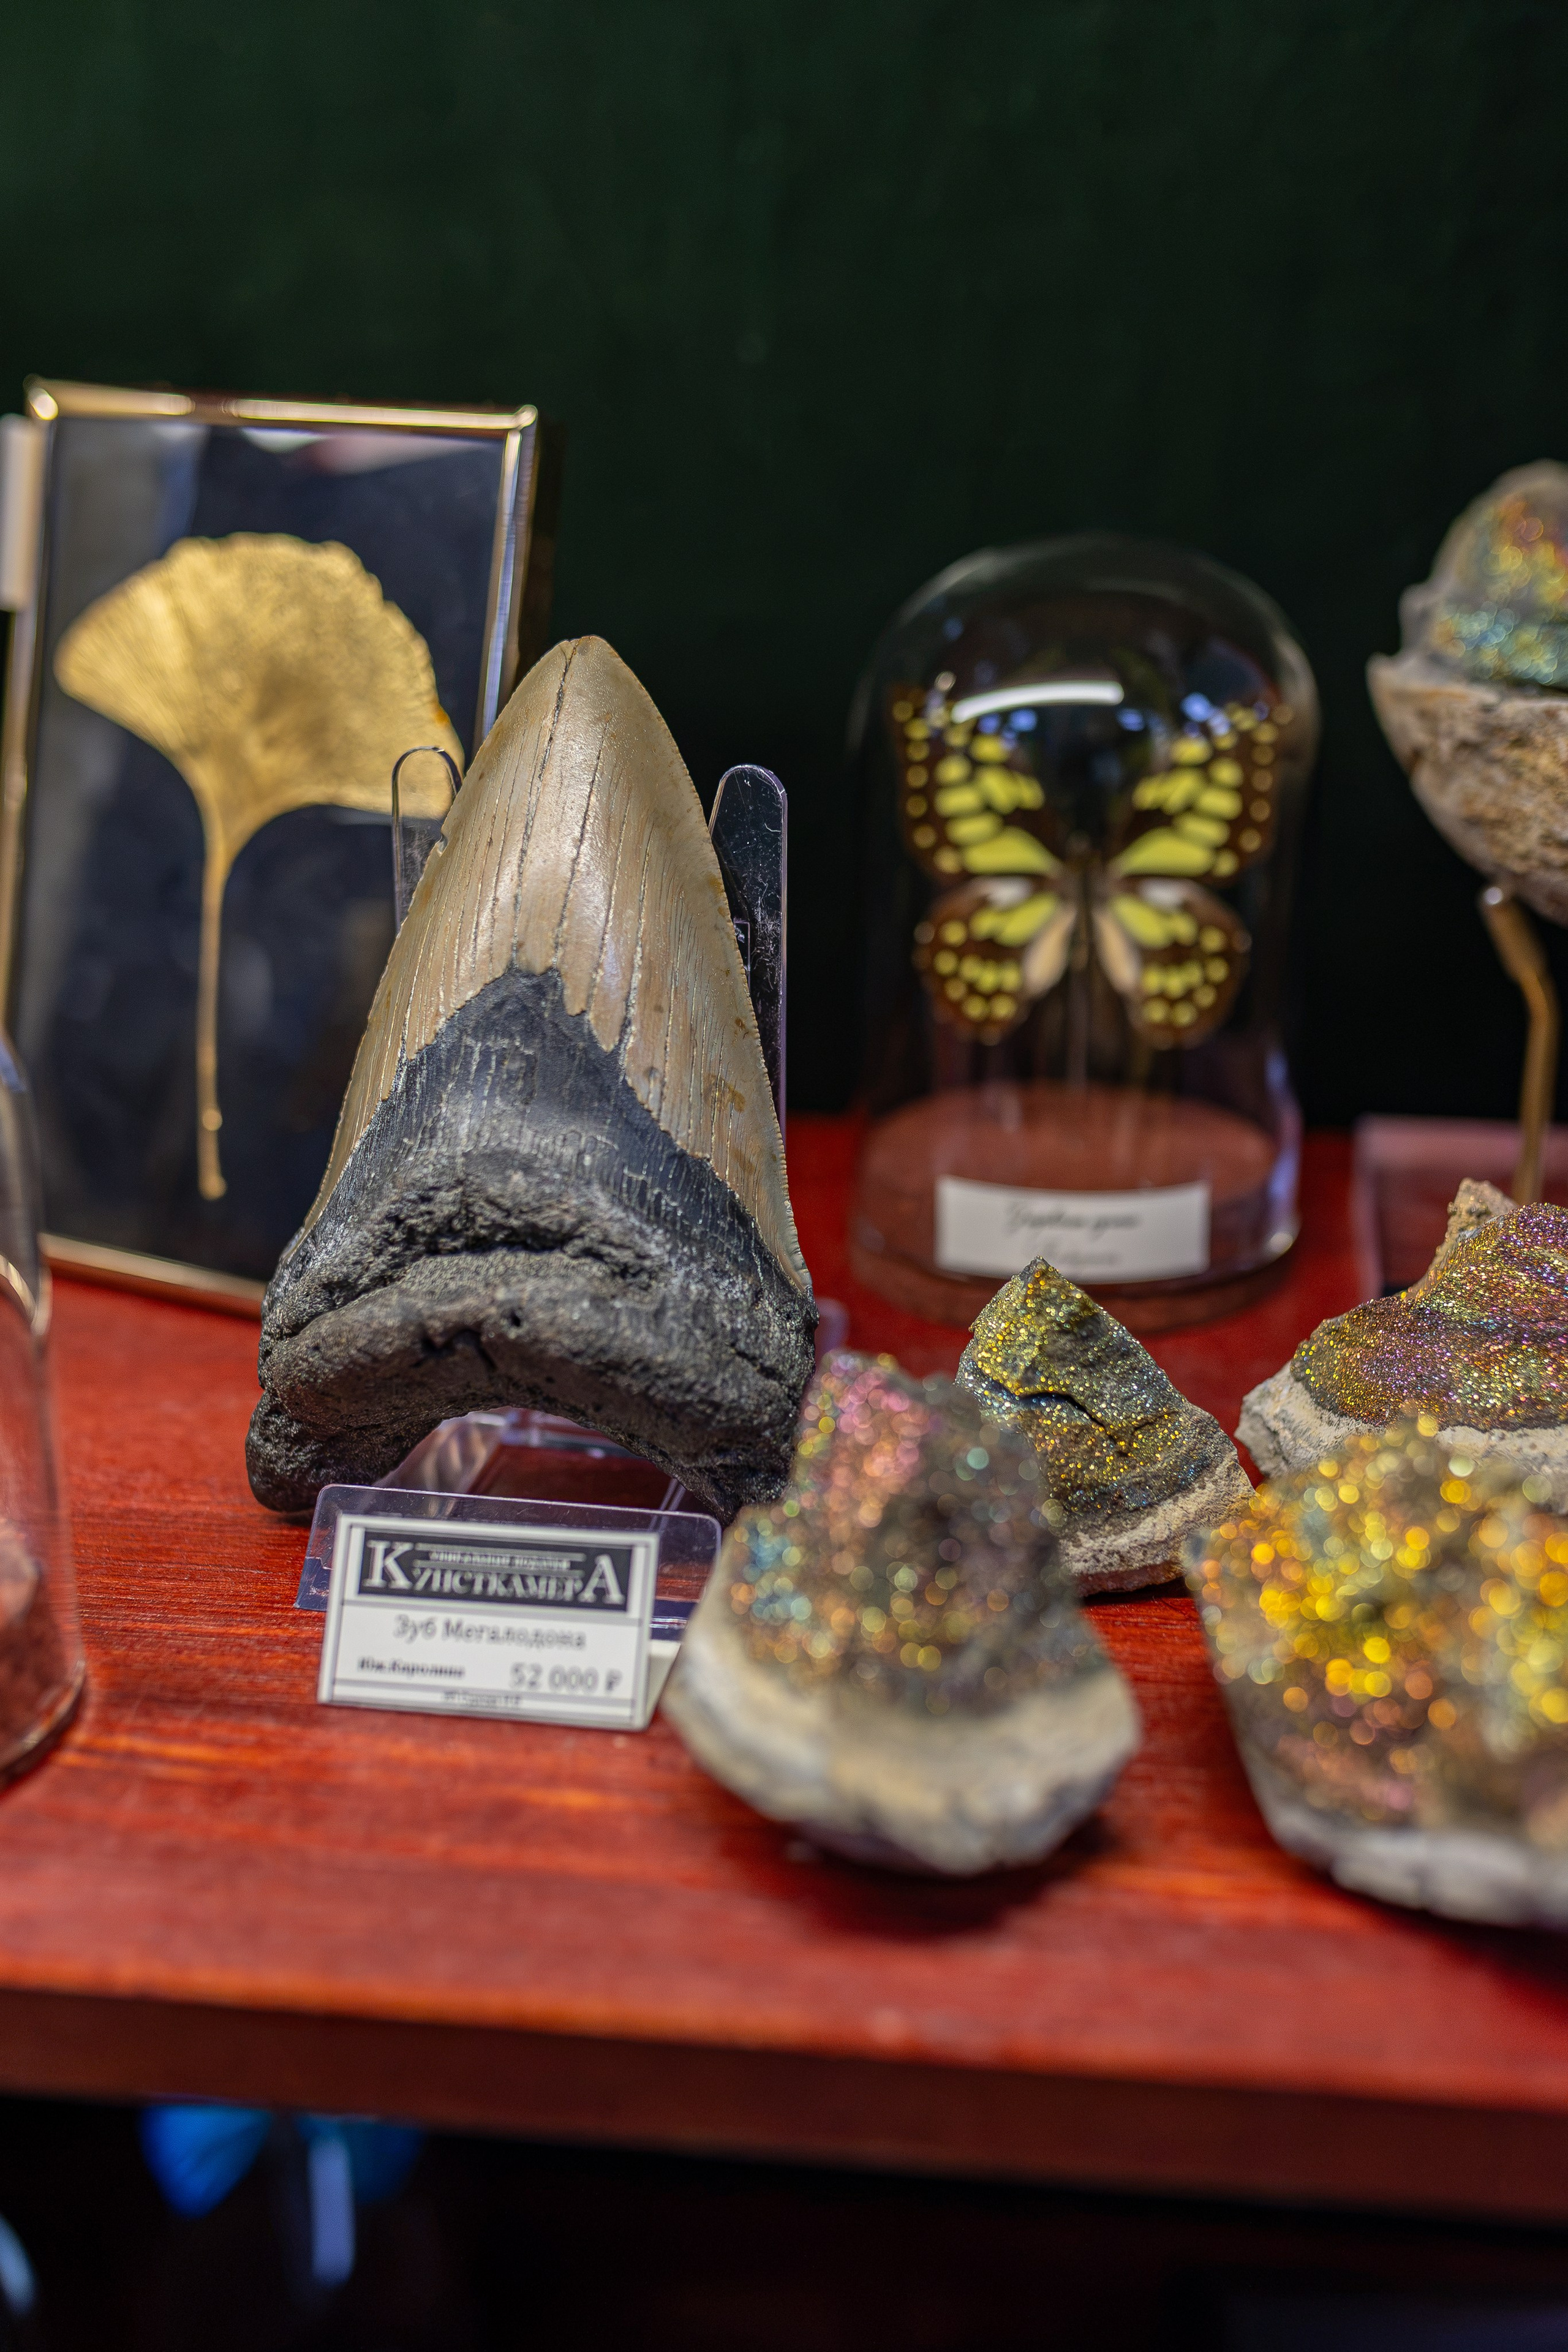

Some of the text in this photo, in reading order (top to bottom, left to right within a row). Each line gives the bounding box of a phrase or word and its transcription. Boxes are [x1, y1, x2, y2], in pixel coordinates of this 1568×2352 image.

[362, 1540, 625, 1605] КУНСТКАМЕРА
[394, 1615, 587, 1650] Зуб Мегалодона
[510, 1662, 543, 1691] 52
[550, 1665, 598, 1694] 000
